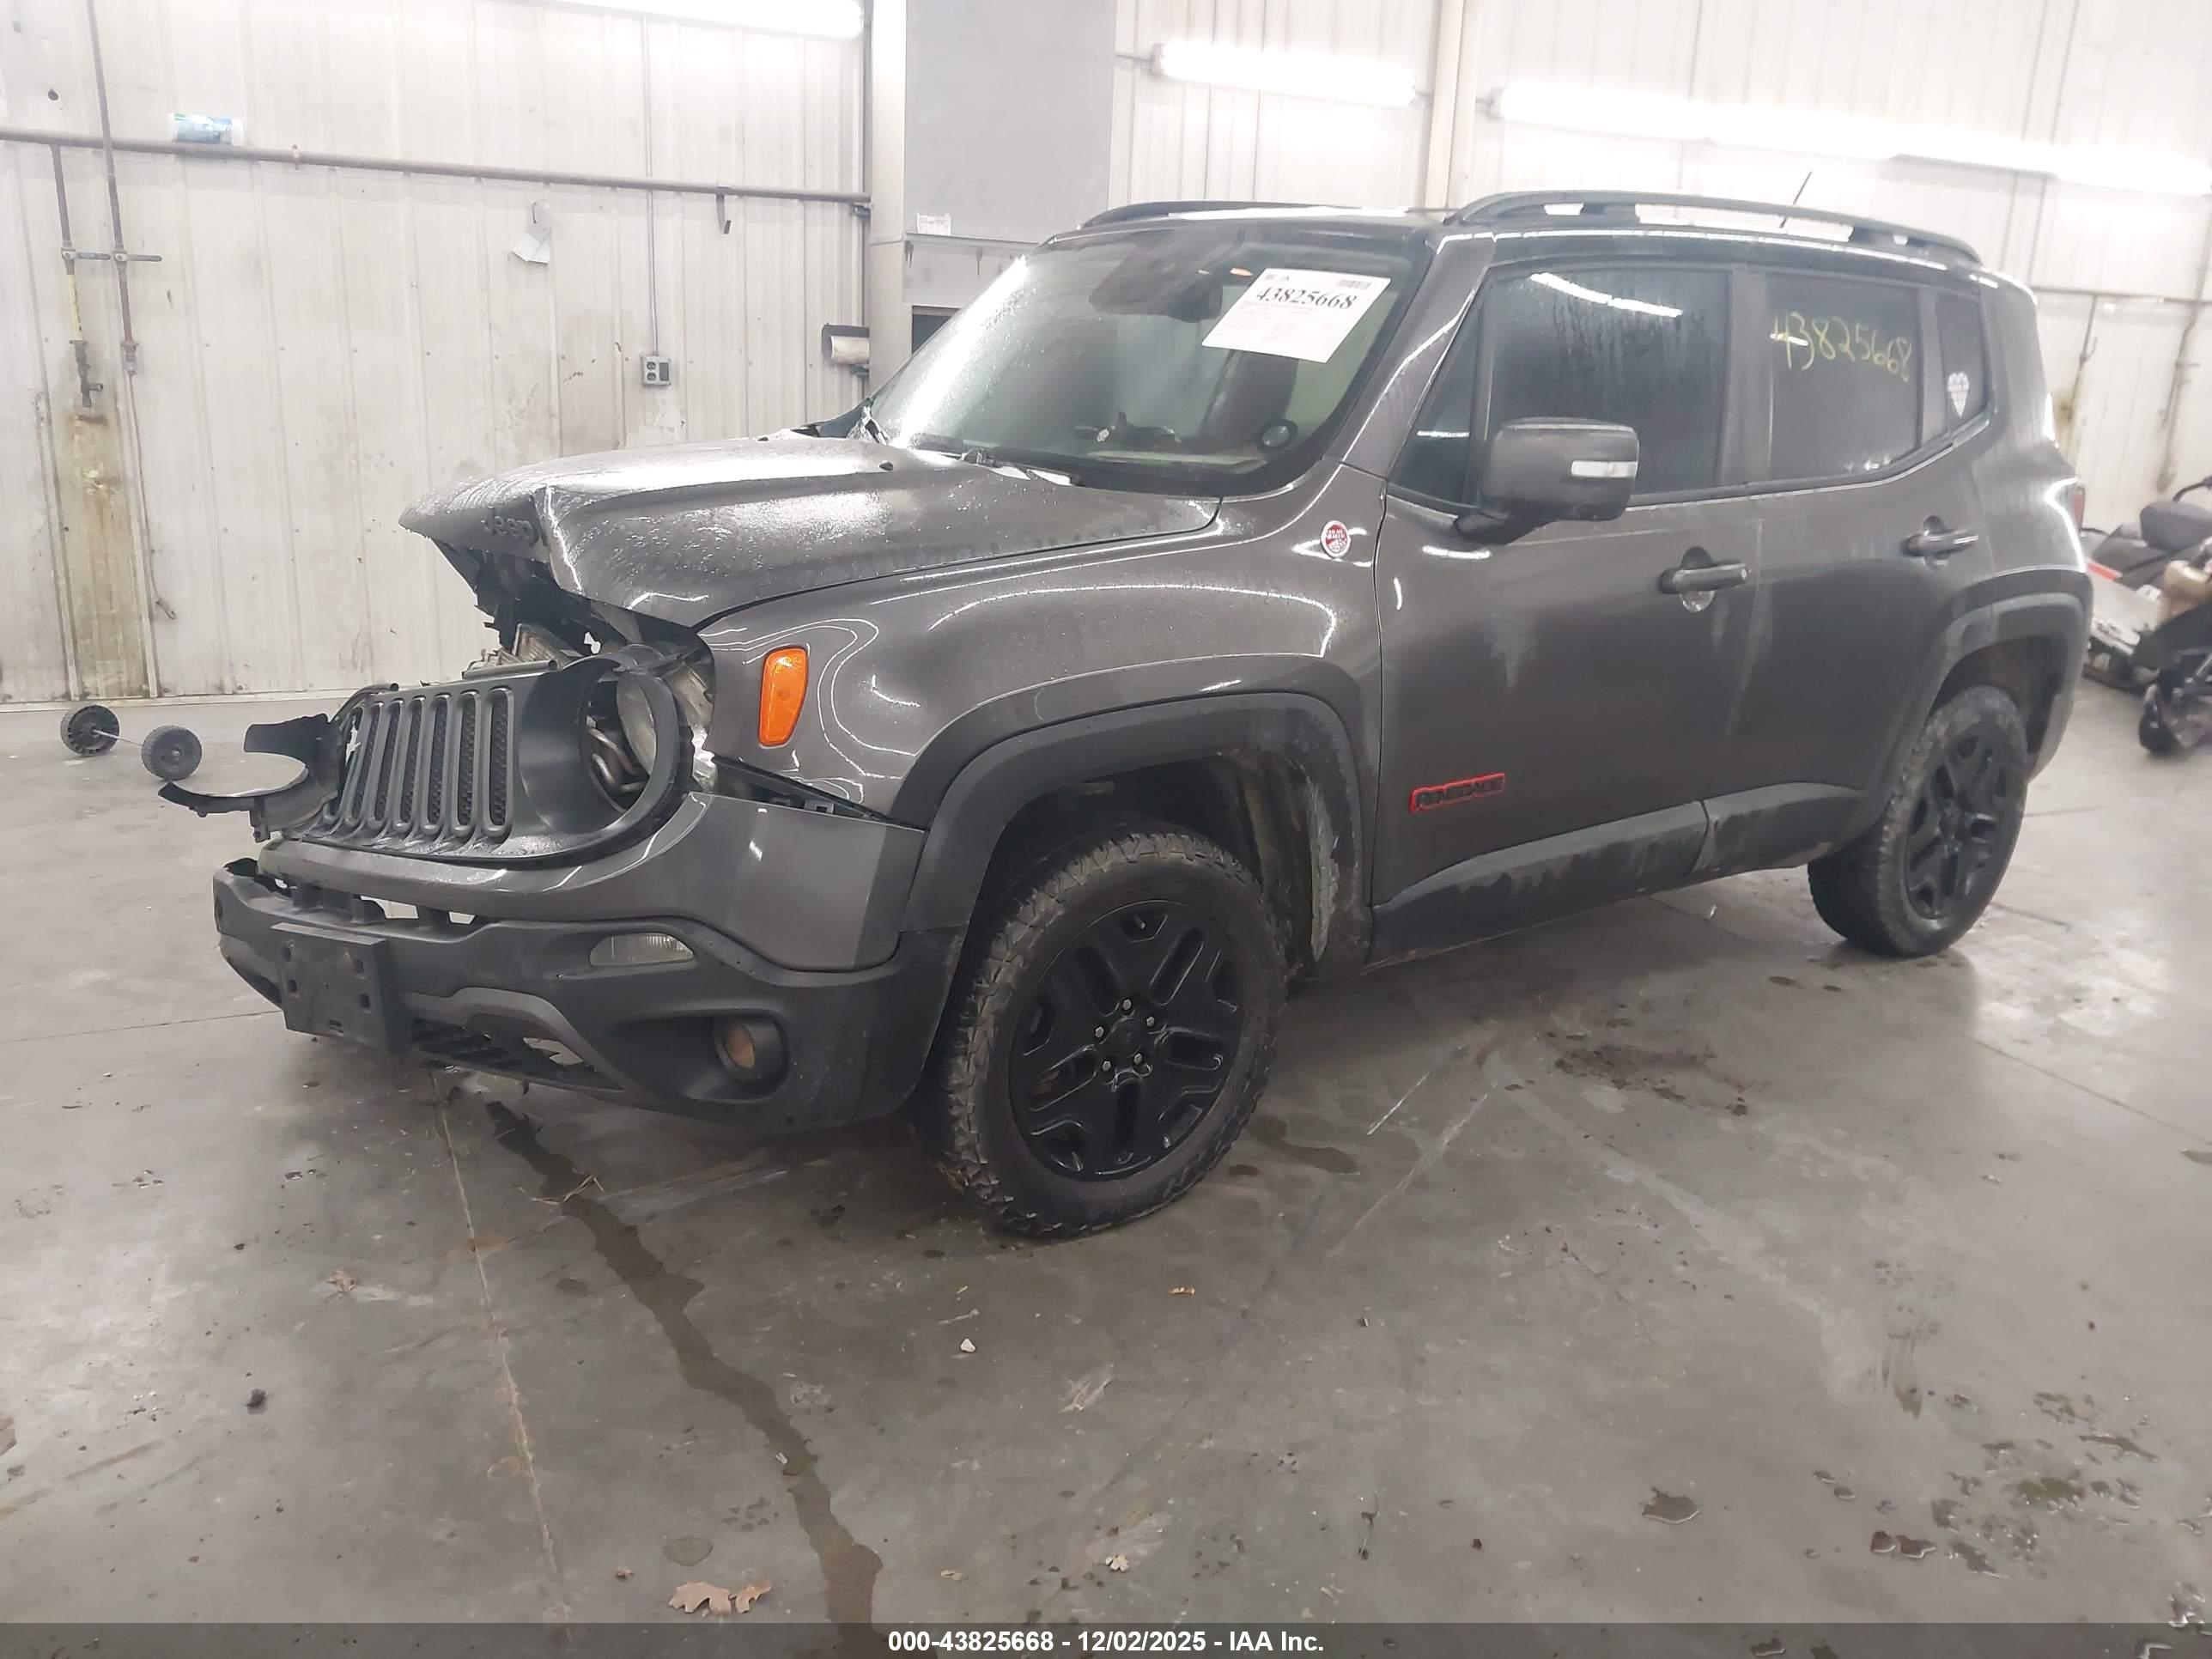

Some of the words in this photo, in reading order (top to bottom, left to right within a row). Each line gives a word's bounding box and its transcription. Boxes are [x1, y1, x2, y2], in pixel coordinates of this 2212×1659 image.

[1256, 286, 1357, 310] 43825668
[1769, 311, 1912, 382] 43825668
[480, 515, 536, 542] Jeep
